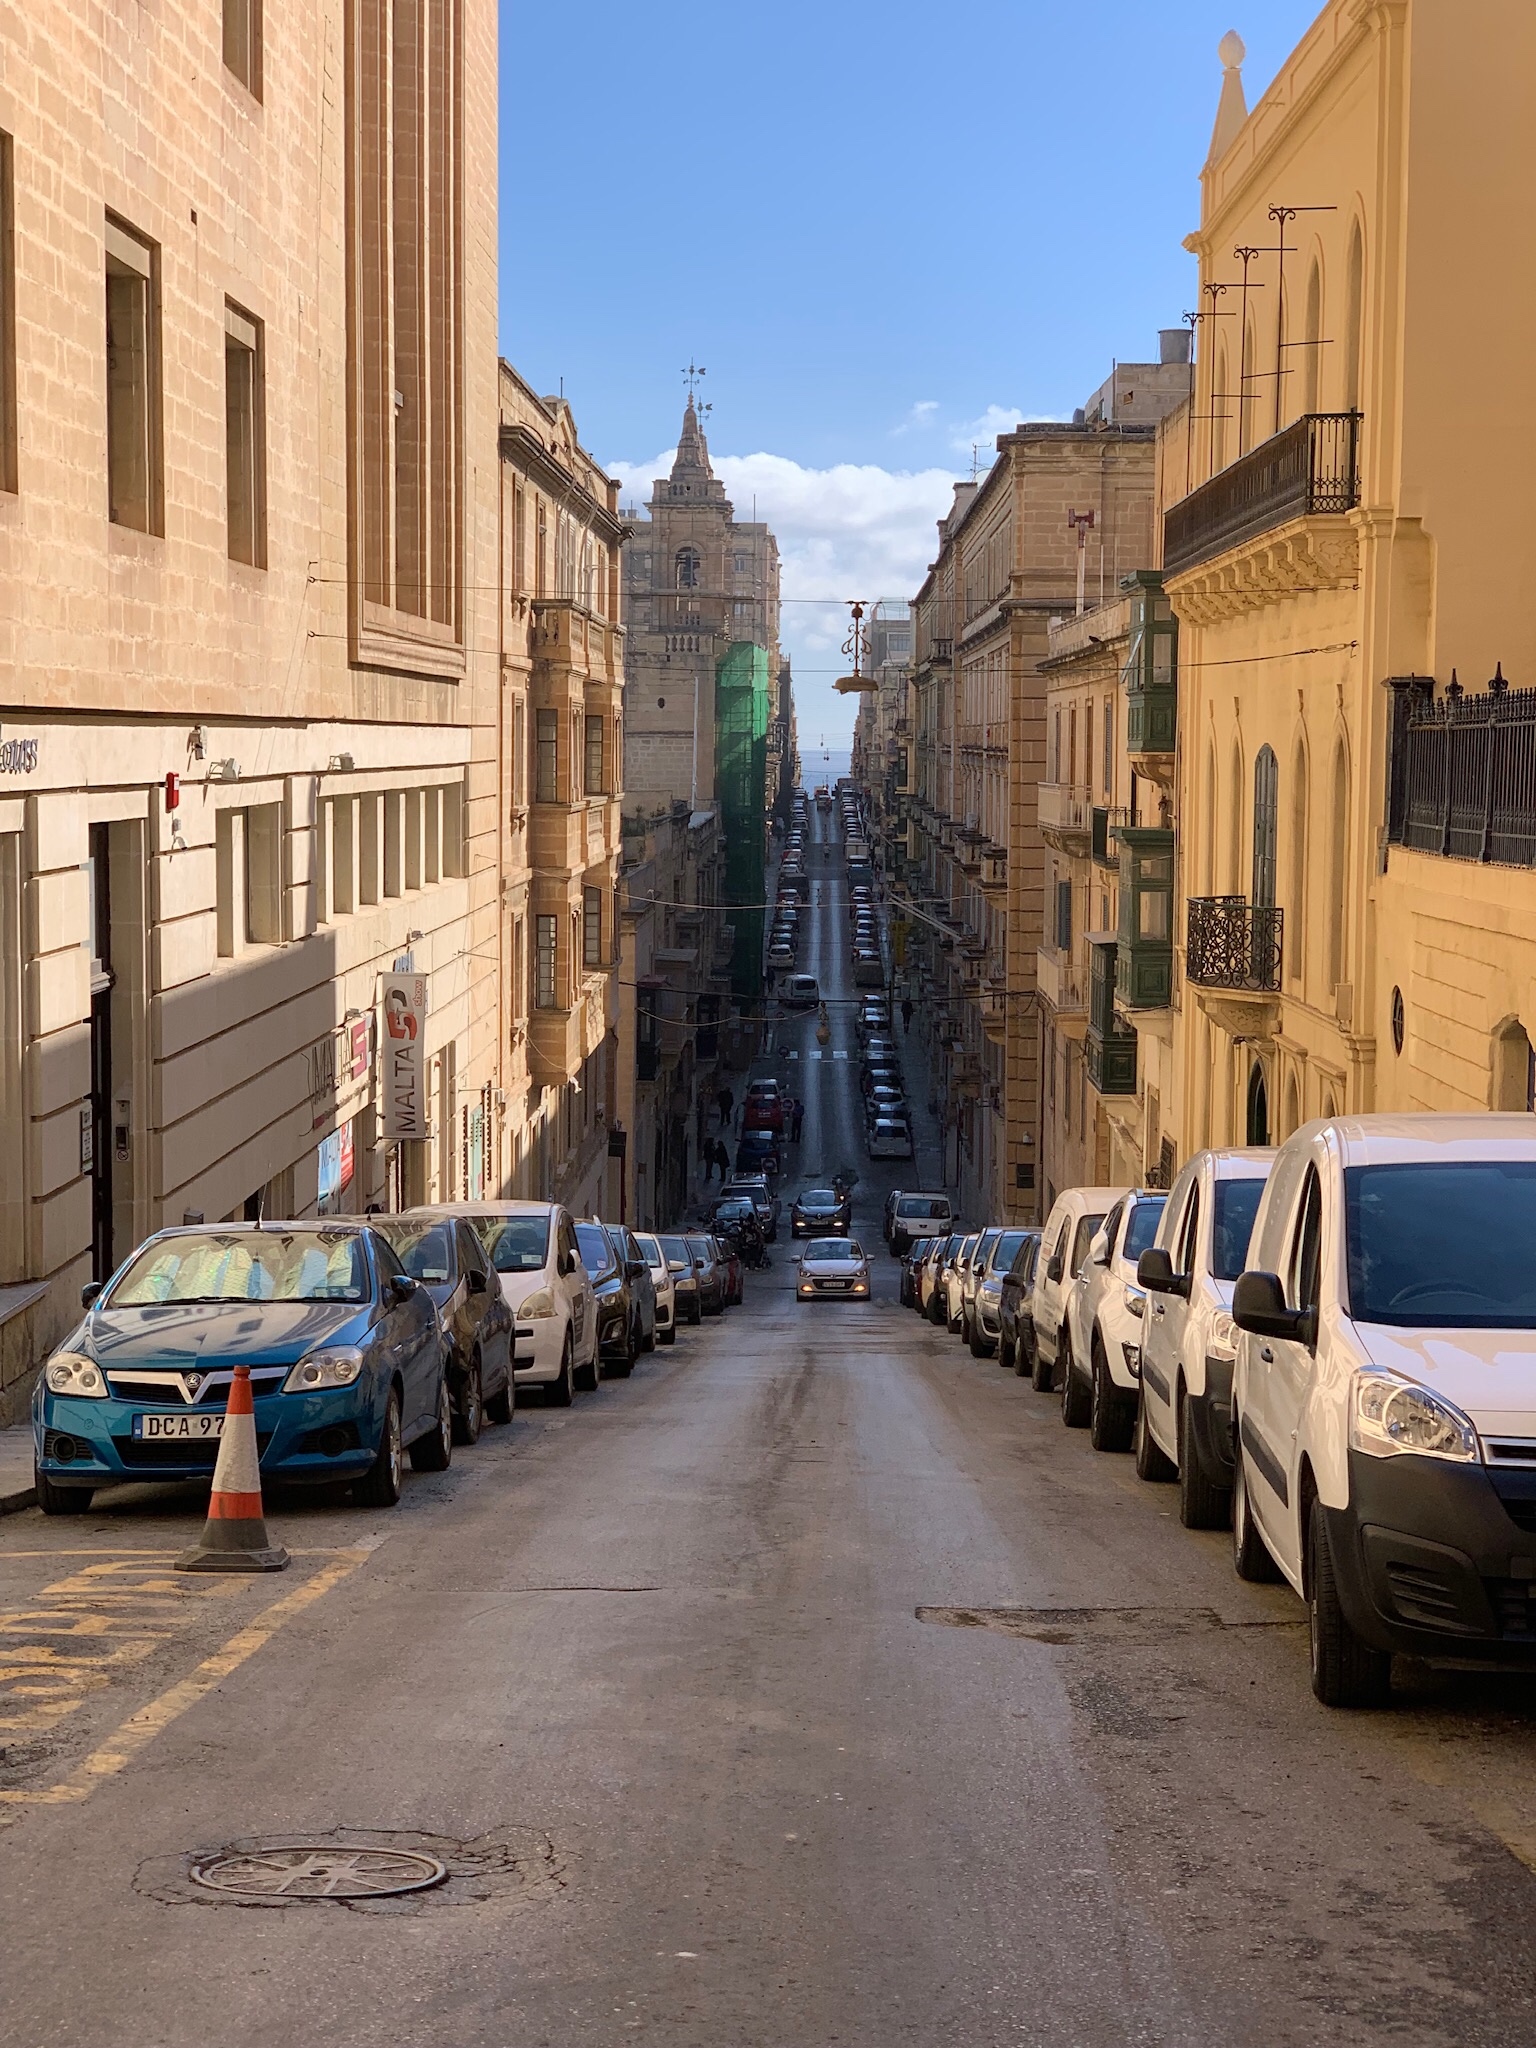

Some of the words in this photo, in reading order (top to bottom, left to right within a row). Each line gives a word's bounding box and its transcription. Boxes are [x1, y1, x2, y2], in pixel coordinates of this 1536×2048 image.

[412, 979, 424, 1007] show
[394, 1045, 416, 1132] MALTA
[147, 1416, 190, 1436] DCA
[200, 1416, 226, 1436] 97
